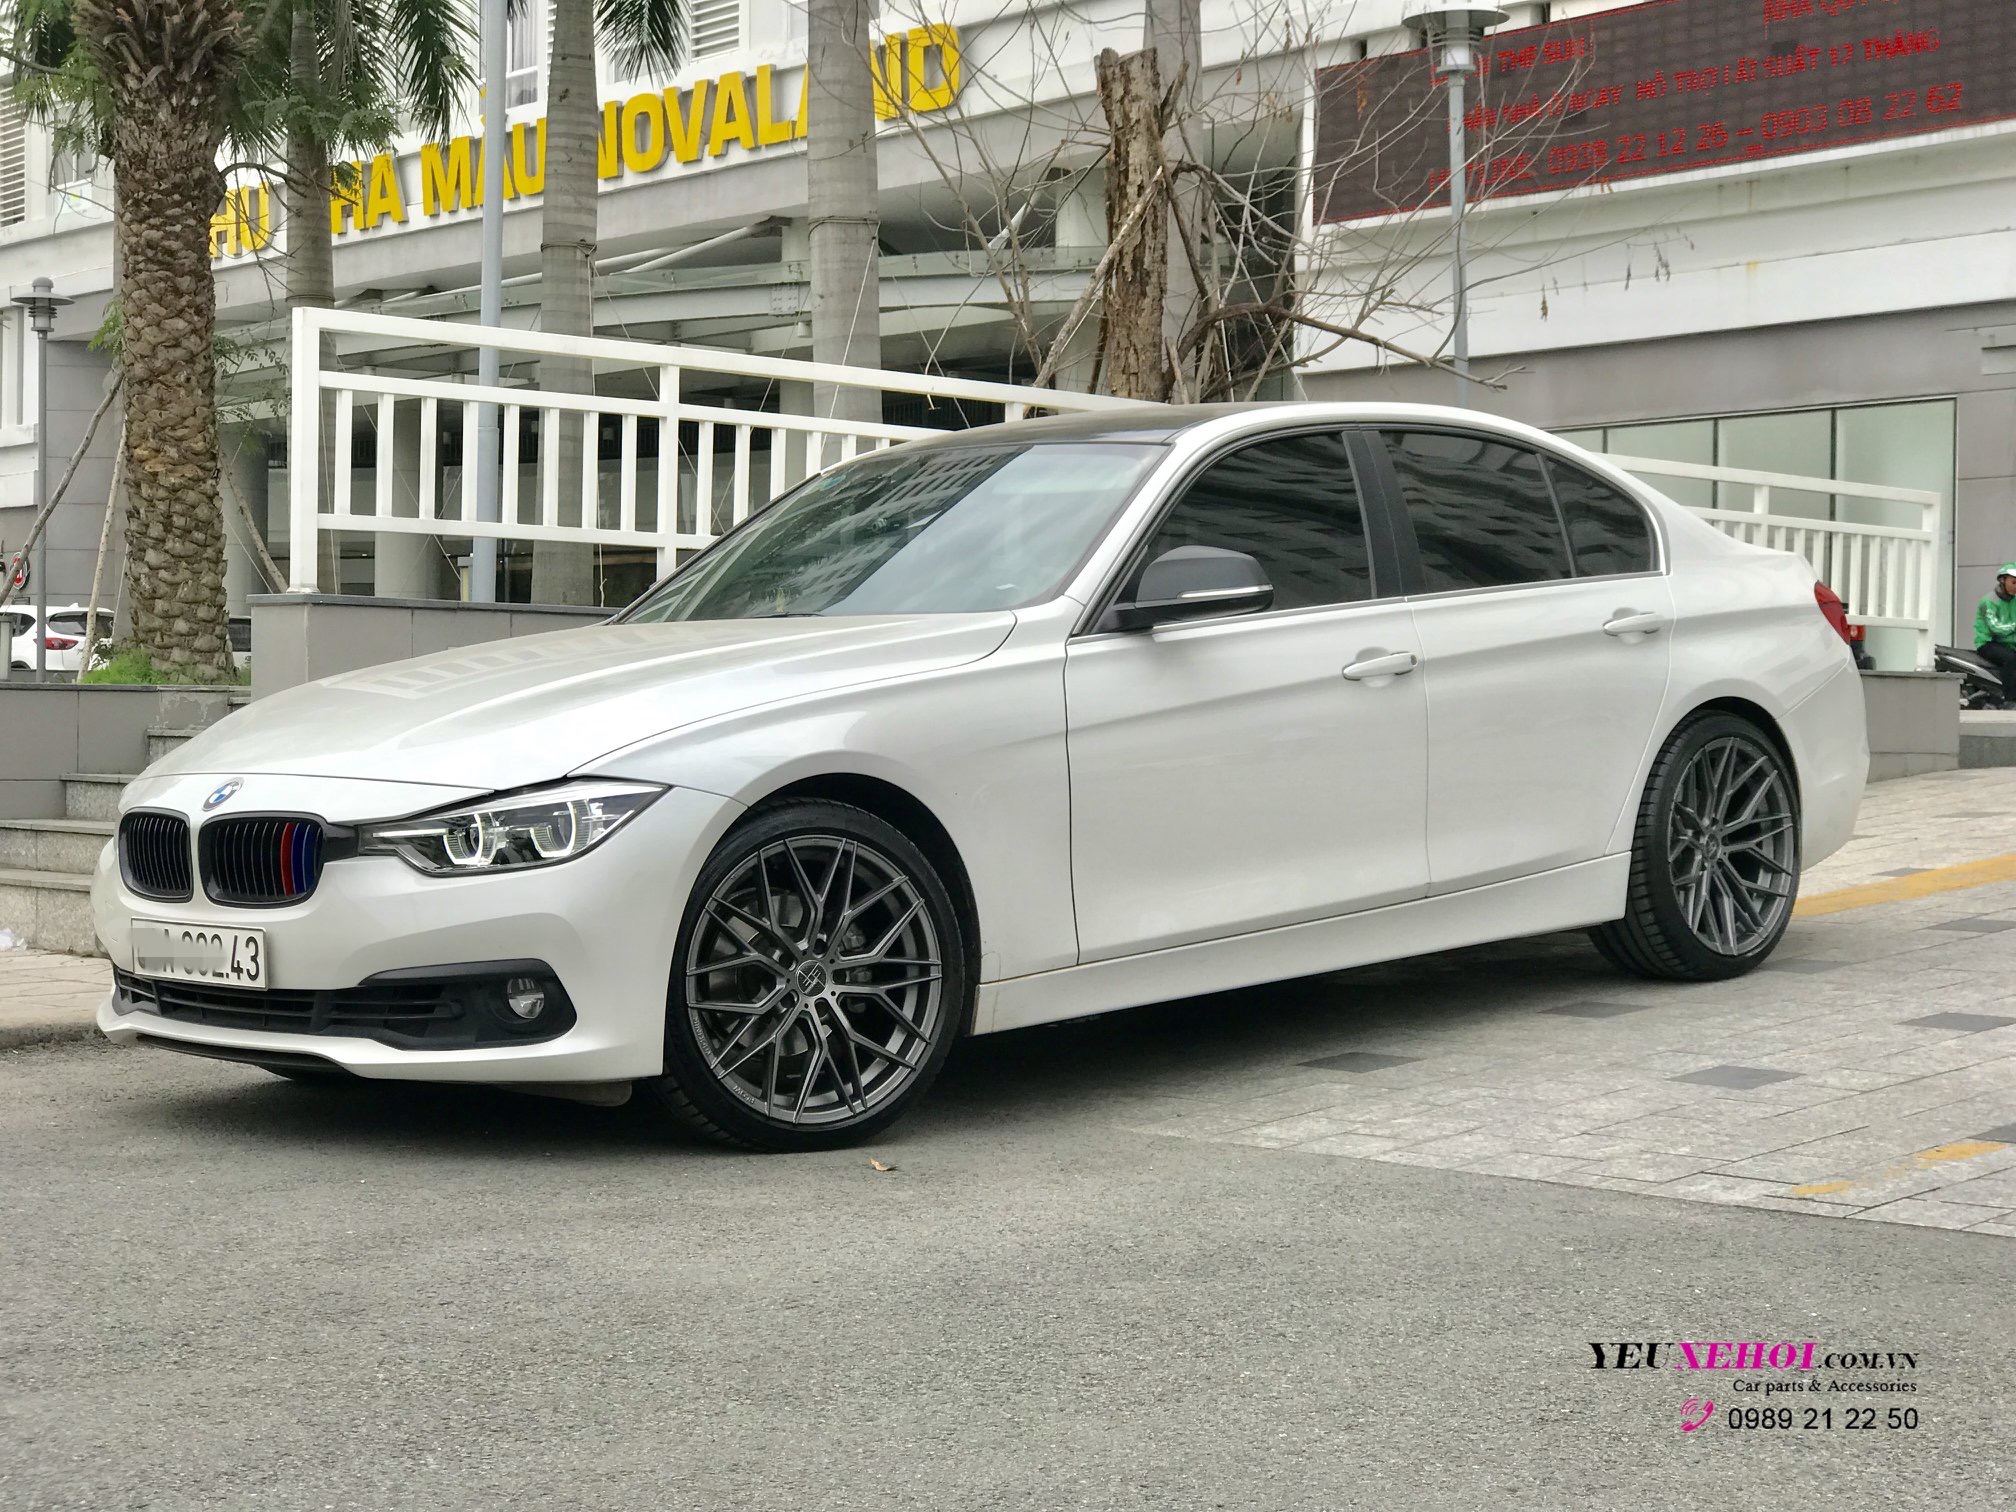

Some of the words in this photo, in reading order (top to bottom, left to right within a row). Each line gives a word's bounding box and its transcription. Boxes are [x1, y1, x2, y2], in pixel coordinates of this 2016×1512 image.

[1616, 133, 1648, 164] 22
[1656, 127, 1687, 158] 12
[1695, 120, 1729, 151] 26
[1761, 103, 1828, 140] 0903
[1837, 96, 1873, 128] 08
[1883, 89, 1918, 121] 22
[1925, 81, 1964, 114] 62
